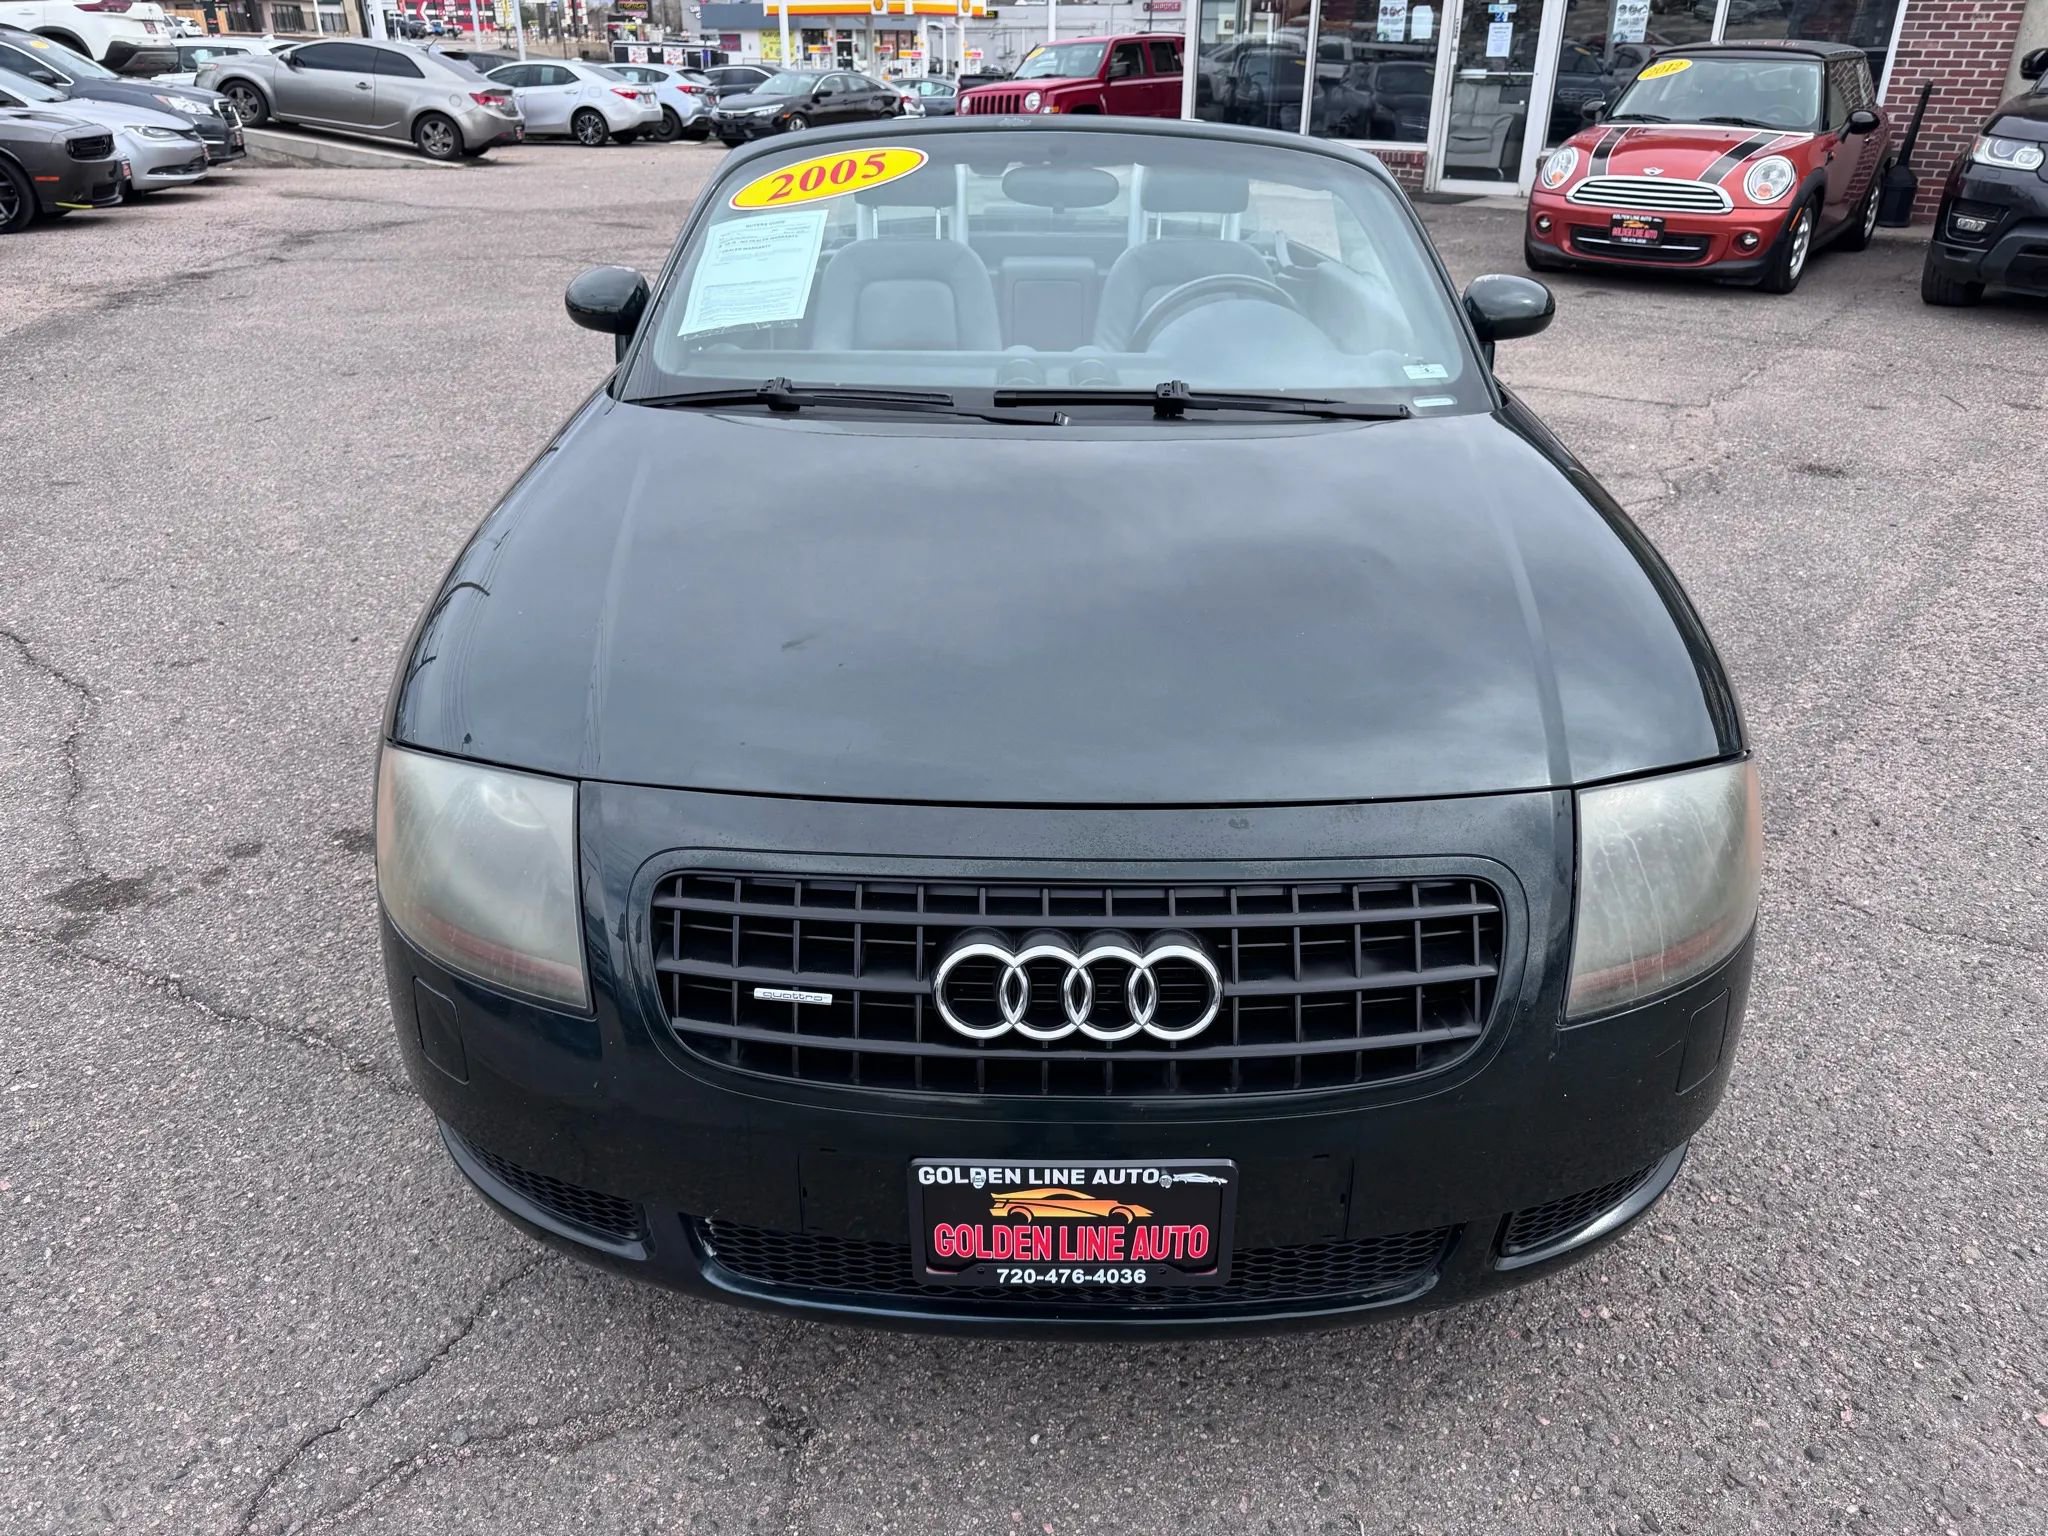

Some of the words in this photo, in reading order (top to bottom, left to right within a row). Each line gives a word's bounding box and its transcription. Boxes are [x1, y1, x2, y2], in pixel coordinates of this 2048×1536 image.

[767, 152, 887, 202] 2005
[762, 991, 823, 1001] quattro
[918, 1166, 1021, 1185] GOLDEN
[1028, 1168, 1085, 1185] LINE
[1092, 1168, 1160, 1185] AUTO
[934, 1223, 1051, 1261] GOLDEN
[1059, 1225, 1125, 1261] LINE
[1130, 1224, 1209, 1261] AUTO
[997, 1268, 1147, 1284] 720-476-4036
